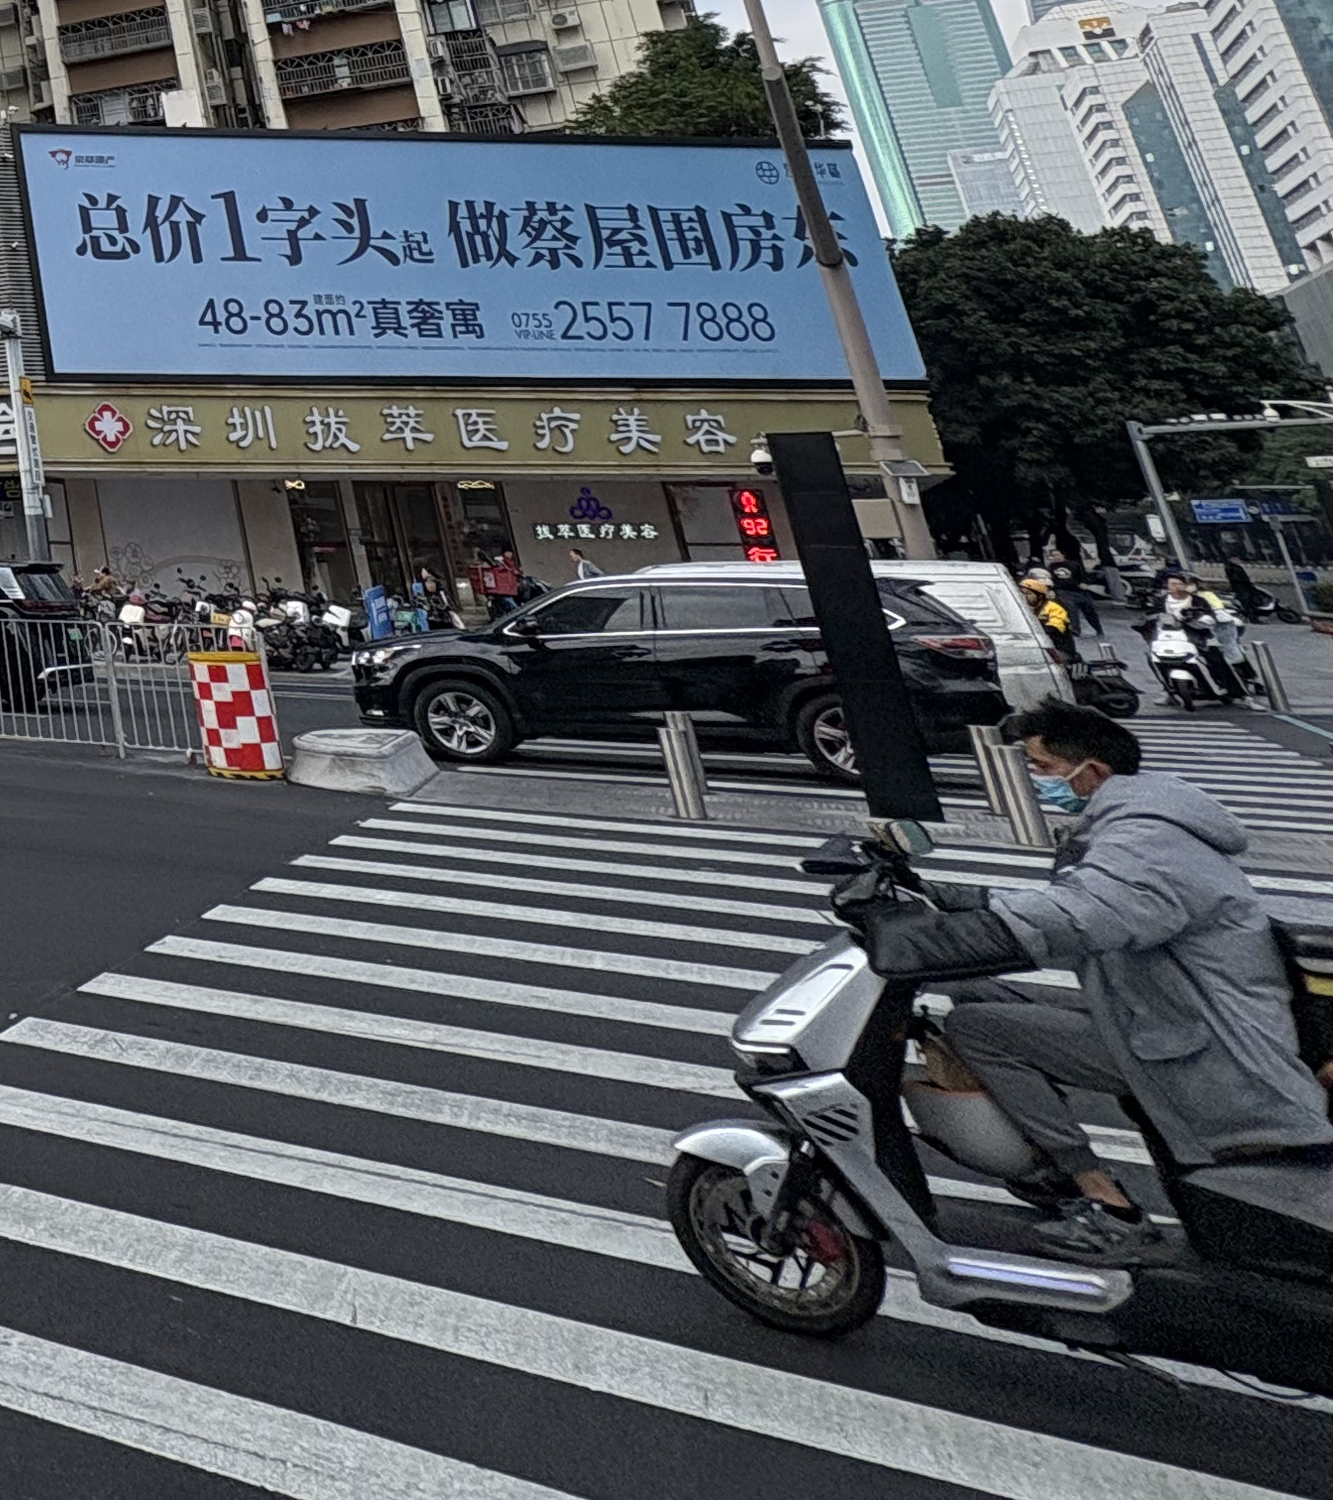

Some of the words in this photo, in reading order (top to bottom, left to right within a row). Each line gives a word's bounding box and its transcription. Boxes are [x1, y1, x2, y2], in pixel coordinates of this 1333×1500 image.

[511, 312, 552, 329] 0755
[554, 301, 652, 342] 2557
[667, 302, 776, 342] 7888
[146, 405, 737, 454] 深圳拔萃医疗美容
[740, 518, 769, 536] 92
